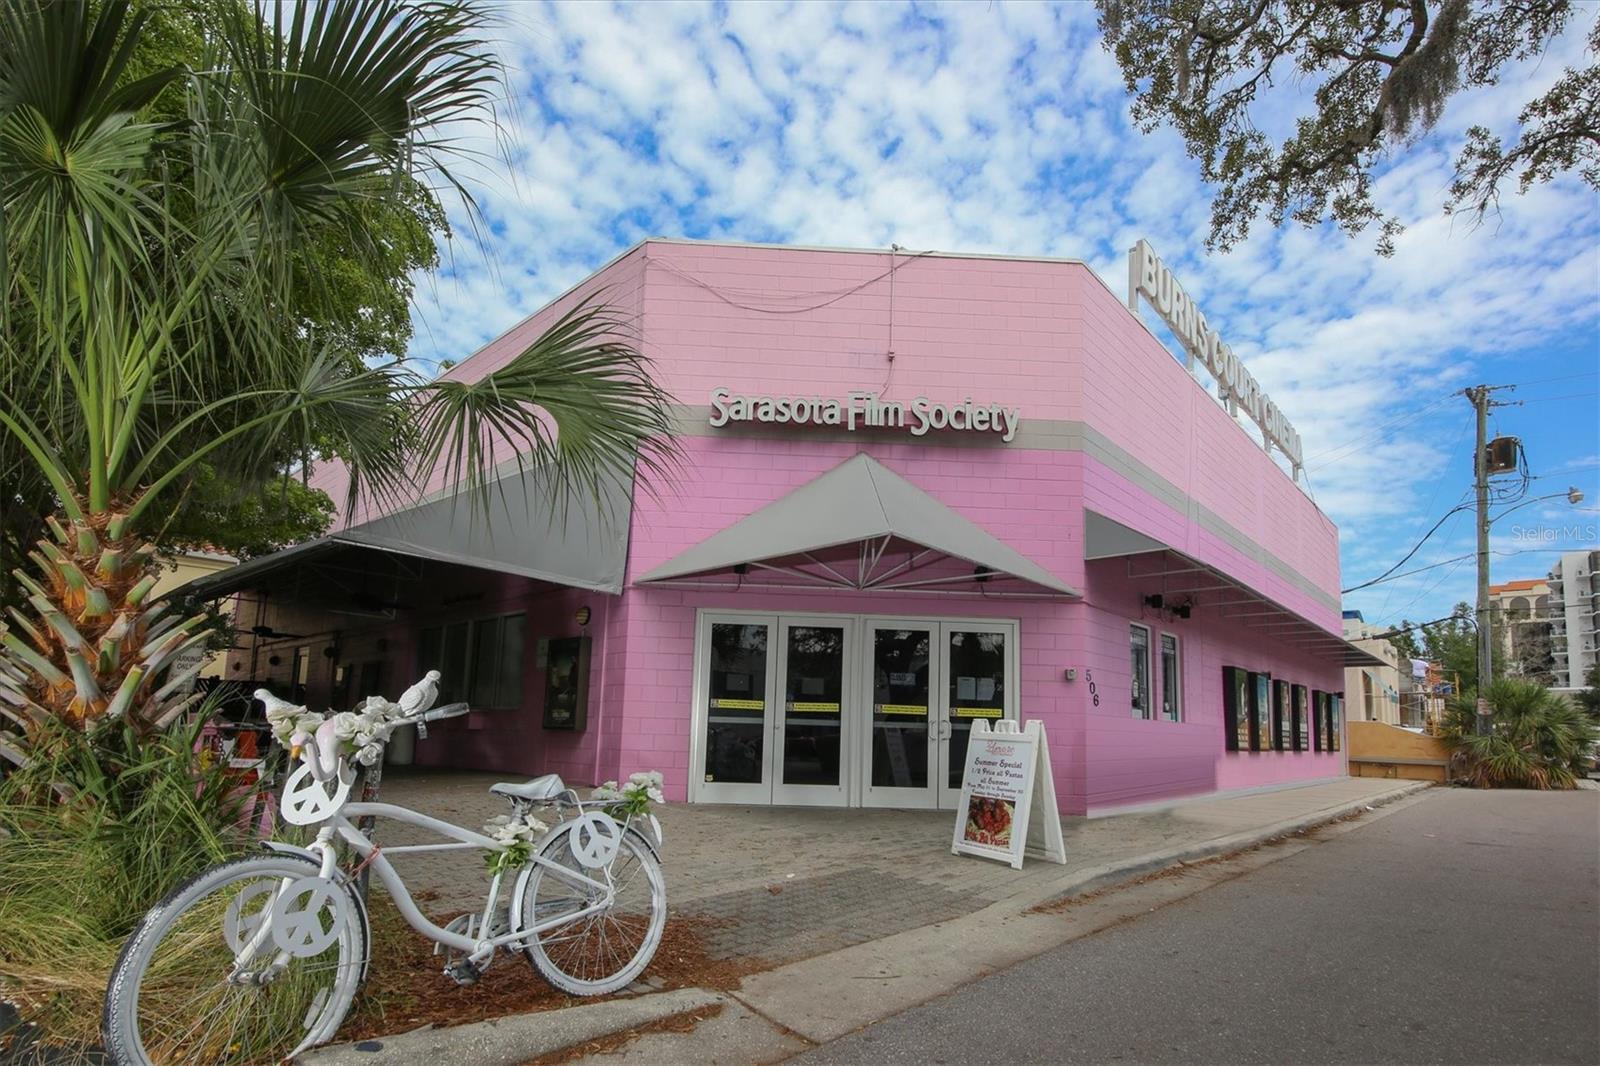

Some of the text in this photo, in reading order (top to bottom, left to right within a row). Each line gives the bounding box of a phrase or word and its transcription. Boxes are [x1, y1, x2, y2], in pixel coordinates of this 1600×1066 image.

[1137, 239, 1208, 362] BURNS
[1208, 331, 1260, 421] COURT
[709, 387, 1020, 442] Sarasota Film Society
[1086, 669, 1099, 707] 506
[974, 757, 1022, 769] Summer Special
[988, 777, 1009, 786] Summer
